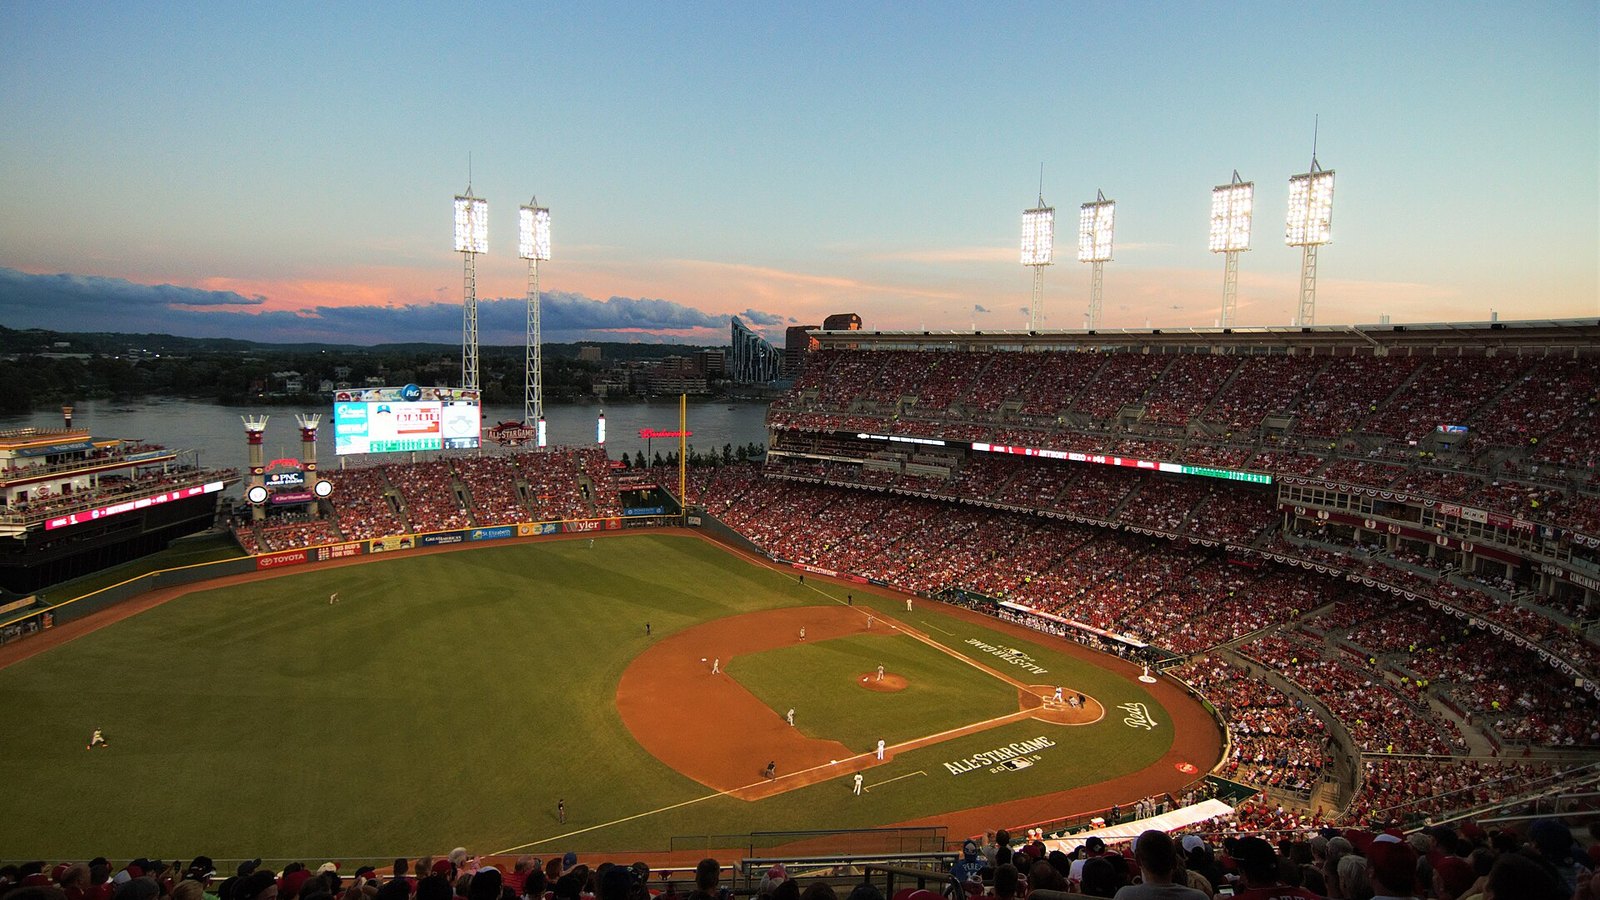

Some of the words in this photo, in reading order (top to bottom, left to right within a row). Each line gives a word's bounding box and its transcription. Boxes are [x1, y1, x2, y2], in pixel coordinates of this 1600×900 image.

[273, 553, 305, 564] TOYOTA
[1569, 571, 1600, 593] CINCINNAT
[1117, 702, 1158, 731] Reds
[1008, 736, 1057, 755] GAME
